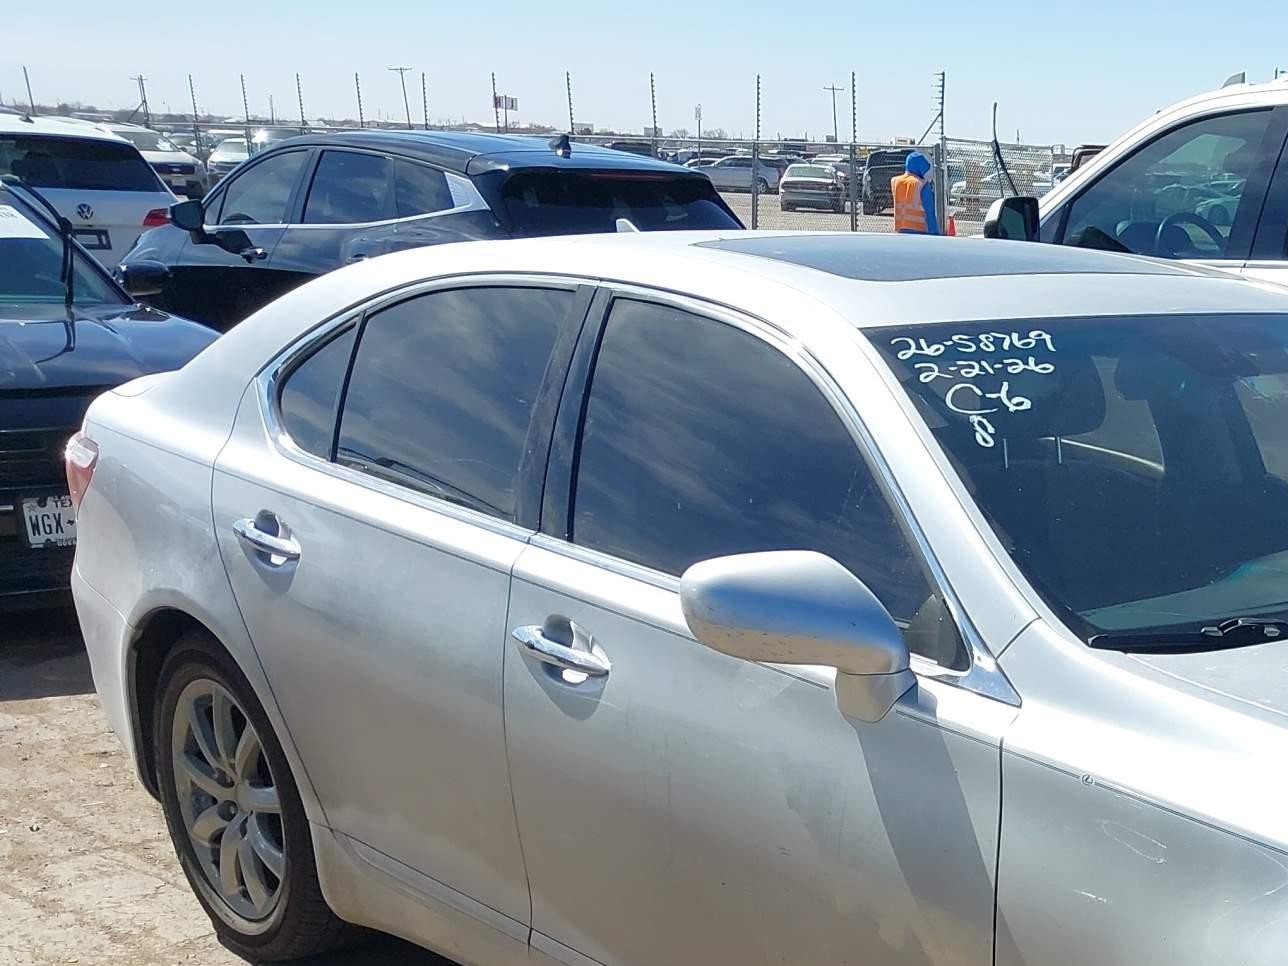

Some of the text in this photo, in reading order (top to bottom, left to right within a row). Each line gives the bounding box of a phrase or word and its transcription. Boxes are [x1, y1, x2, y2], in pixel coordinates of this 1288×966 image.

[890, 330, 1057, 361] 26-58769
[914, 356, 1055, 383] 2-21-26
[945, 381, 1032, 415] C-6
[52, 499, 73, 509] TEX
[29, 512, 65, 537] WGX
